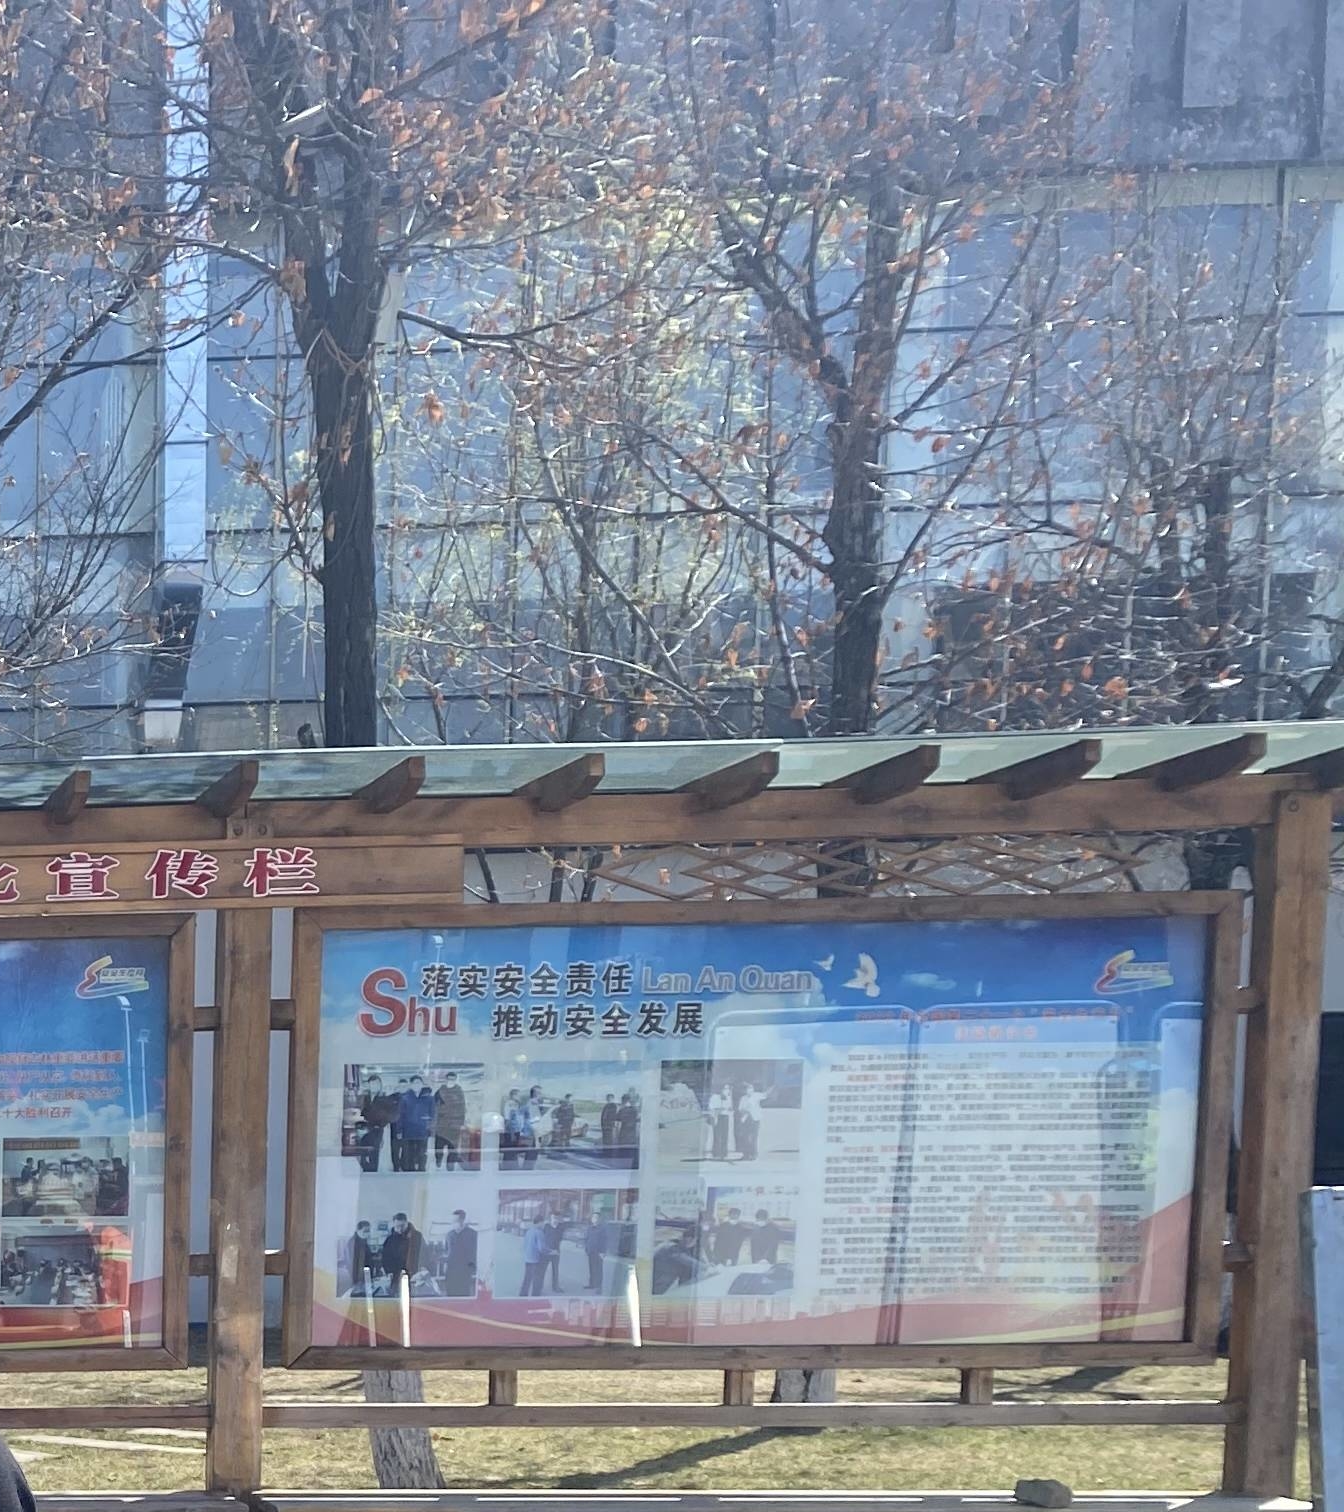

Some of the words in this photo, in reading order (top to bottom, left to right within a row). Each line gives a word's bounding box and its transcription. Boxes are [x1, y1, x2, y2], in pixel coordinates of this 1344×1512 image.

[419, 963, 632, 998] 落实安全责任
[643, 966, 694, 993] Lan
[697, 966, 736, 993] An
[741, 964, 812, 993] Quan
[359, 967, 457, 1036] Shu
[492, 1001, 703, 1038] 推动安全发展
